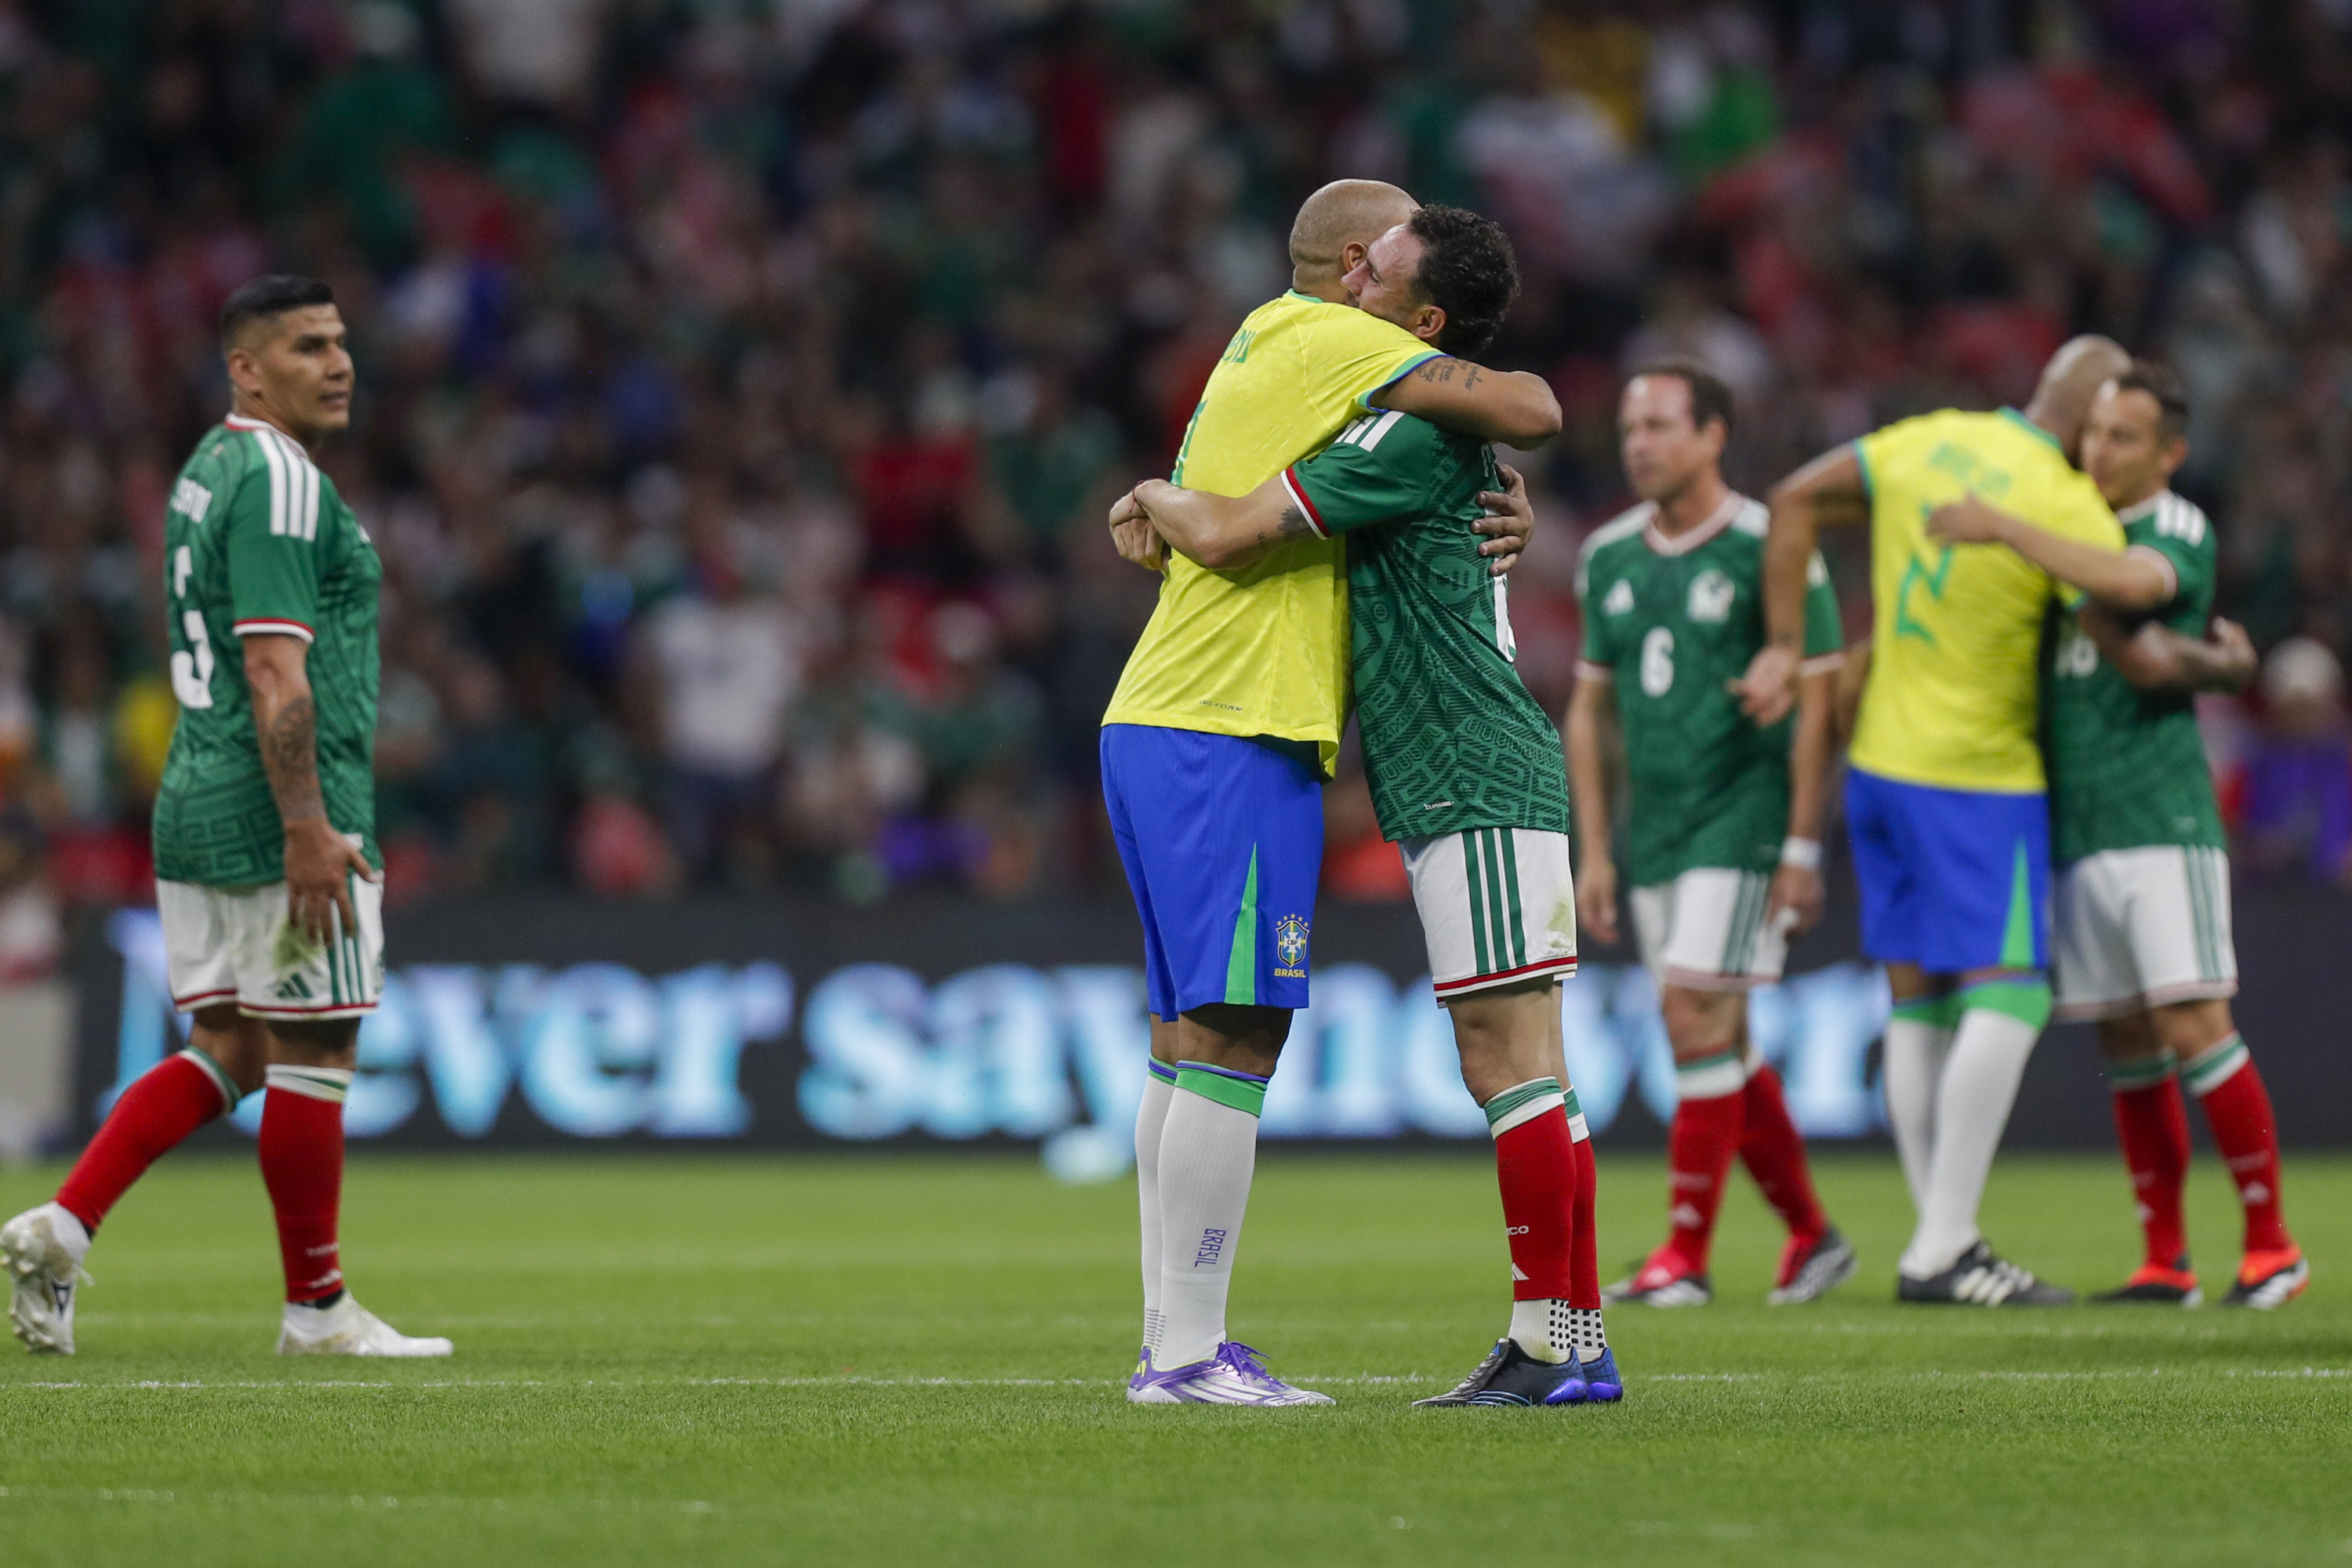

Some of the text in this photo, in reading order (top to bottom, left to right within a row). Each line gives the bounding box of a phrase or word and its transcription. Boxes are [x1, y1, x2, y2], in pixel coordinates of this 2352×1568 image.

[1640, 626, 1675, 697] 6
[1274, 967, 1307, 978] BRASIL
[798, 963, 1154, 1184] say
[1194, 1228, 1227, 1268] BRASIL
